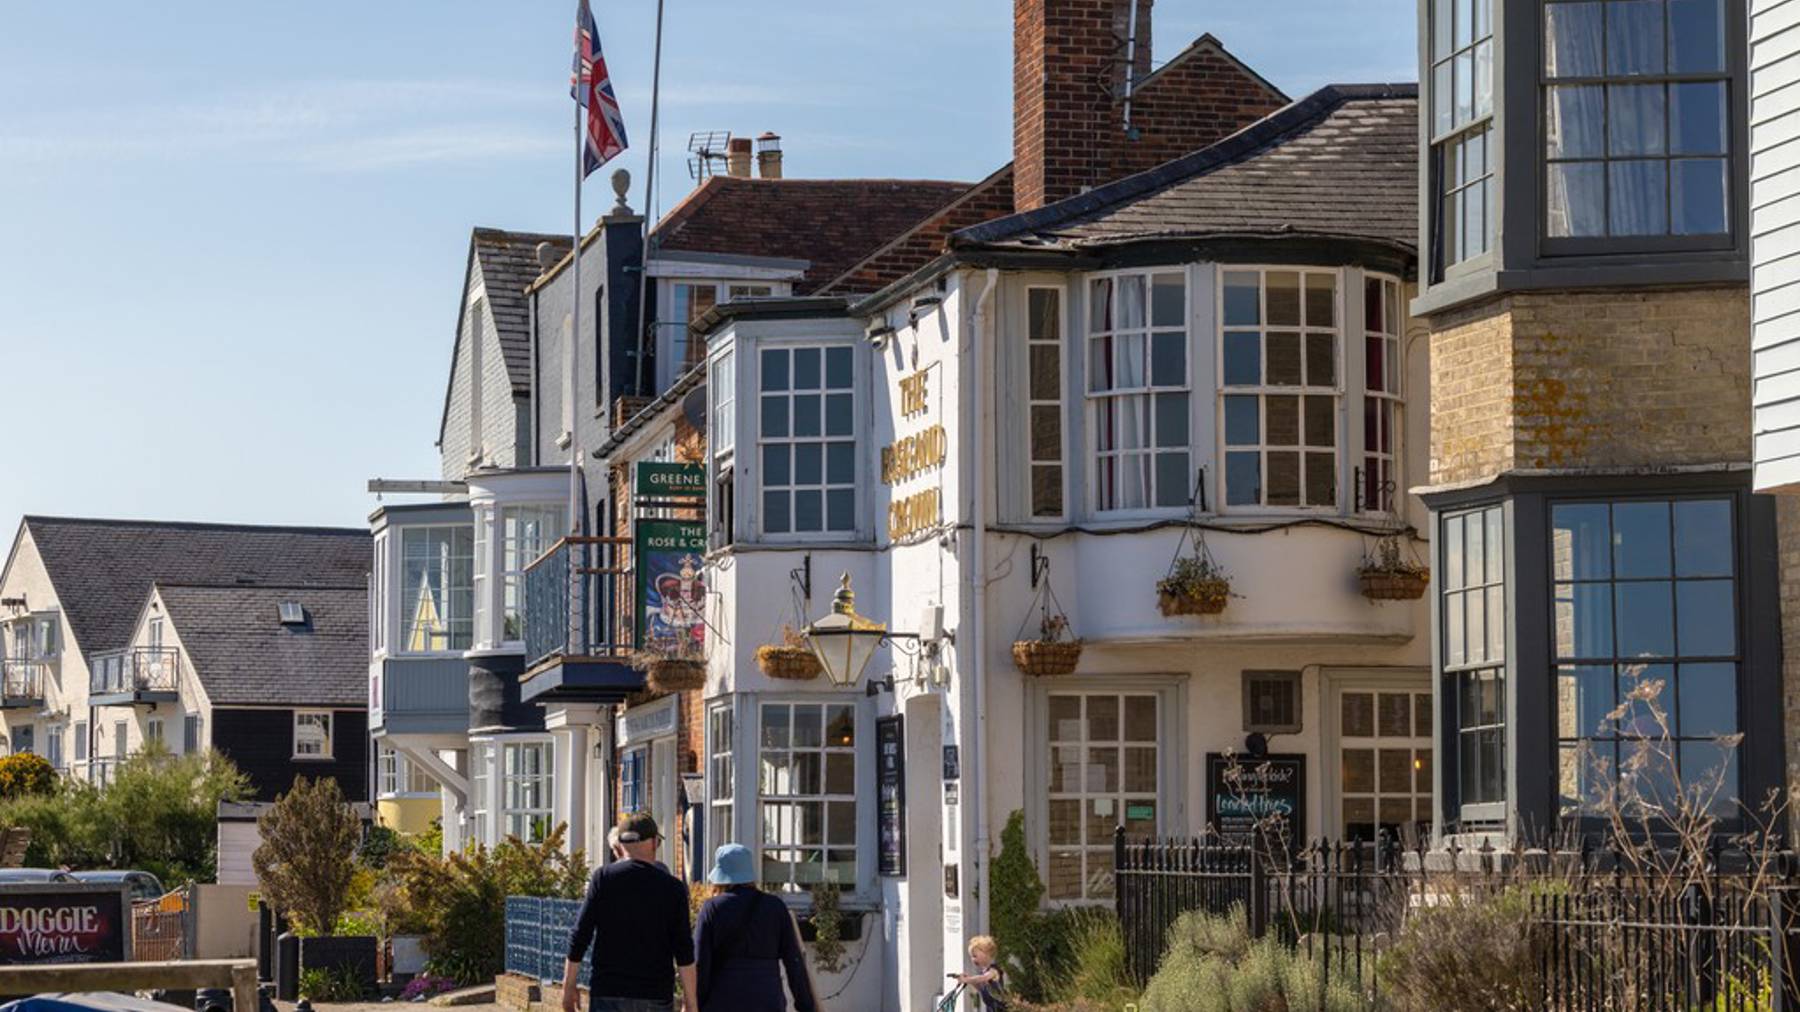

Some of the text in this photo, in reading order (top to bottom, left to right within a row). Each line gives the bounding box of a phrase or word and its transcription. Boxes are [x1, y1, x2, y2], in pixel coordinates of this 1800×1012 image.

[898, 372, 929, 418] THE
[649, 473, 701, 485] GREENE
[680, 527, 702, 536] THE
[648, 537, 705, 548] ROSE & CR
[0, 906, 99, 934] DOGGIE
[16, 929, 88, 957] Menu
